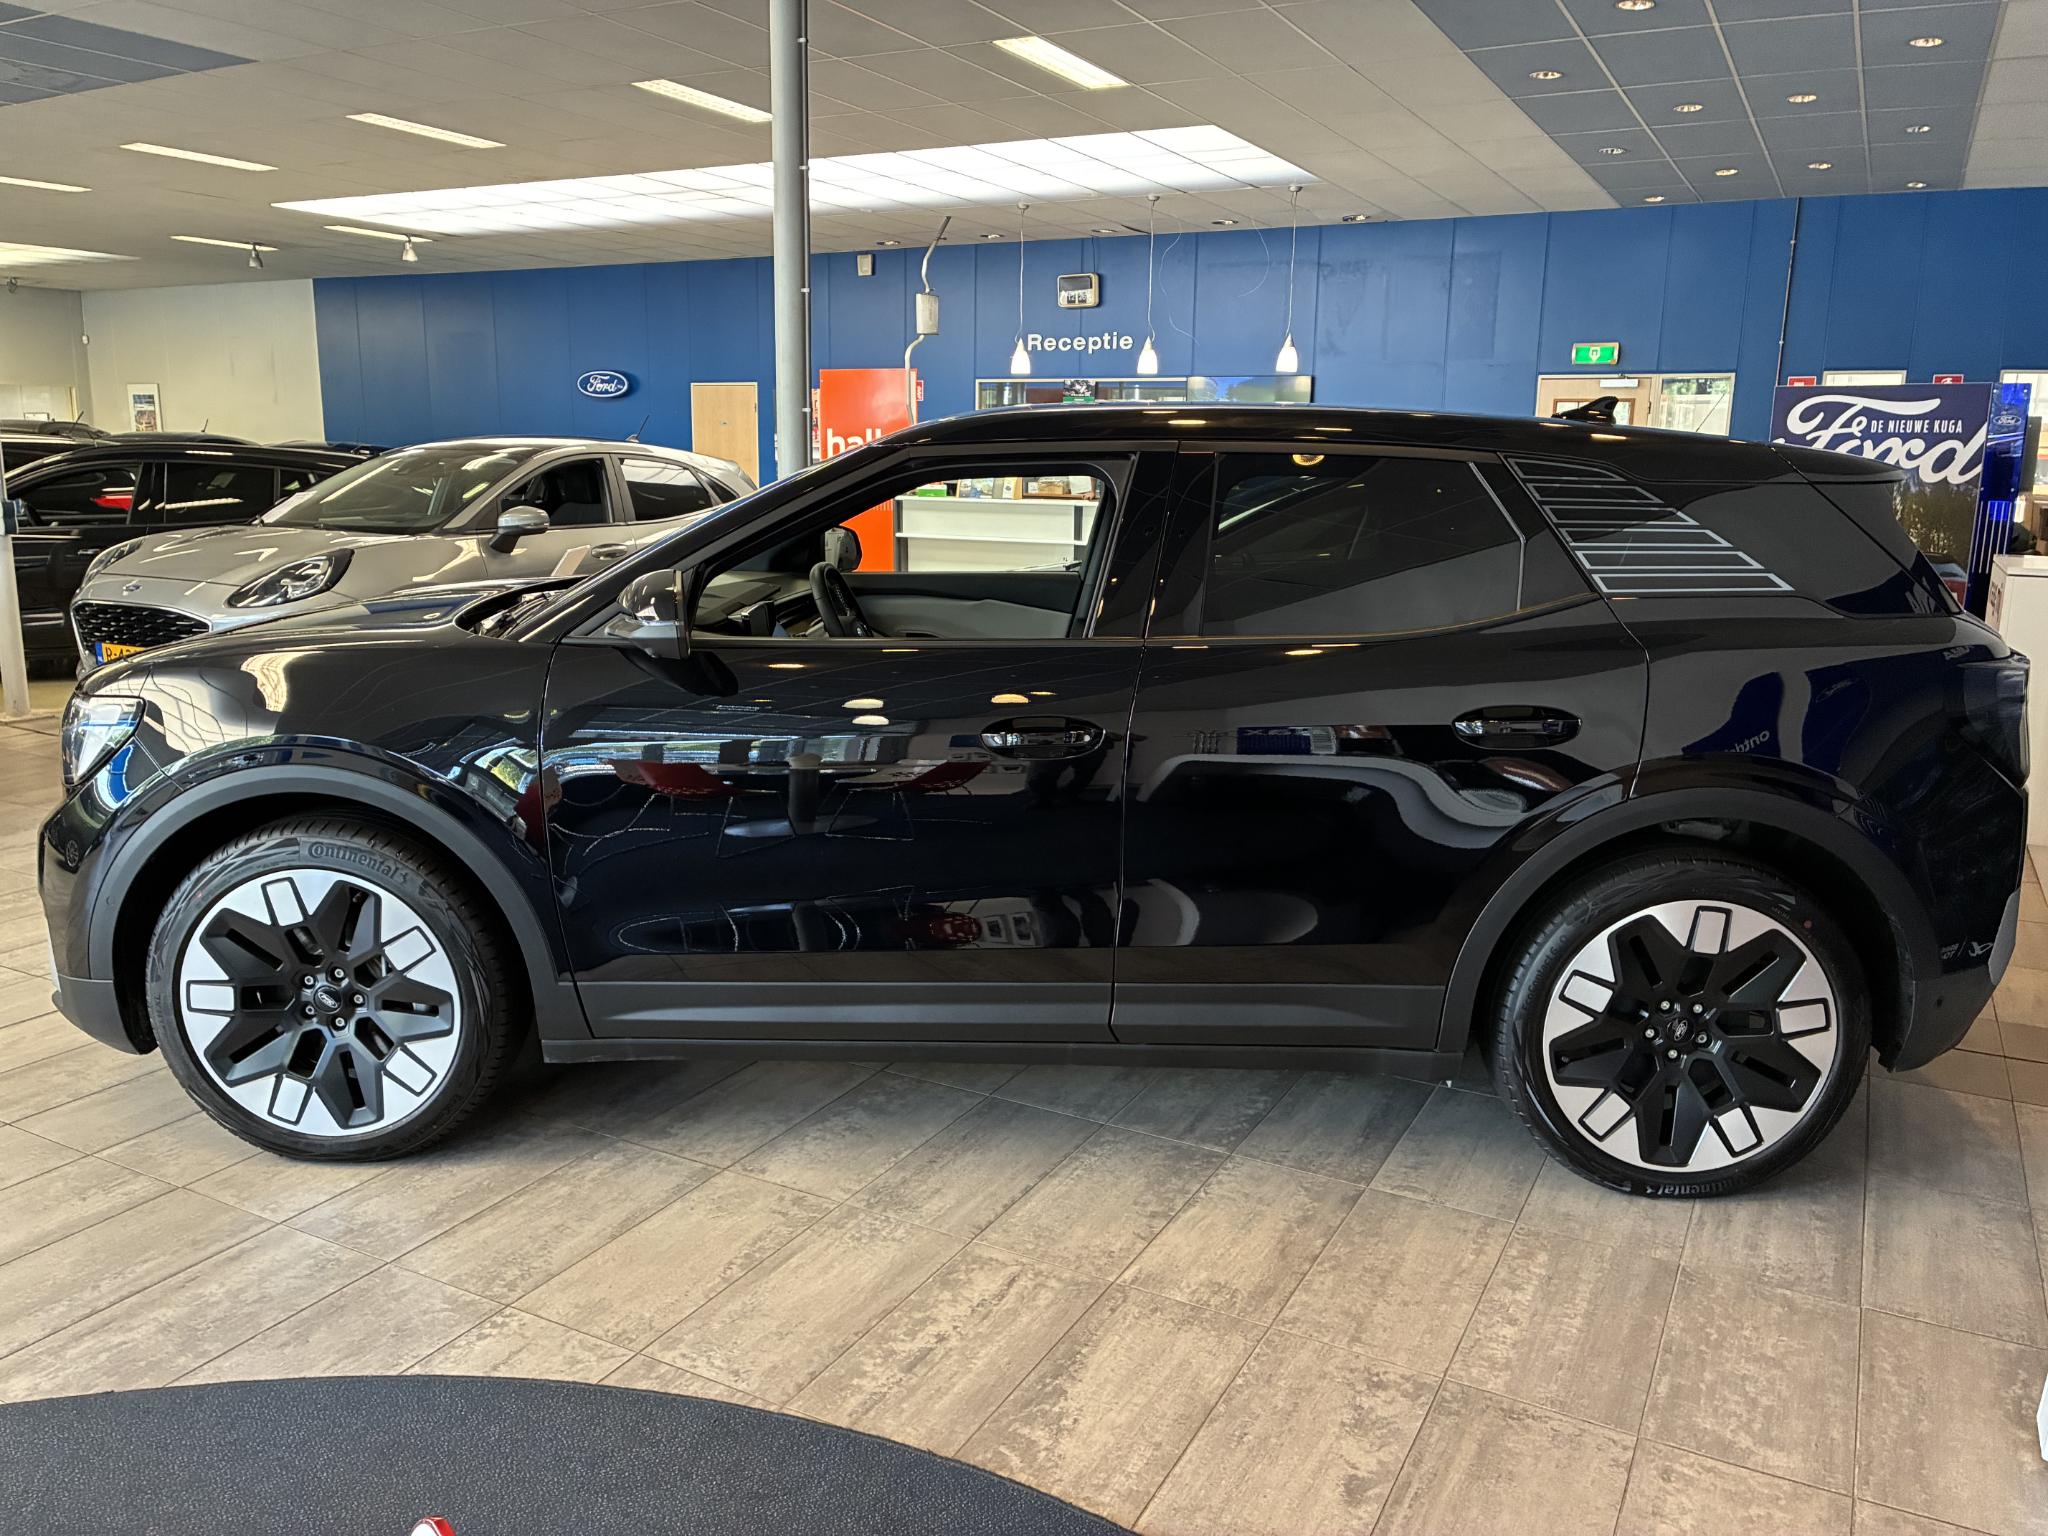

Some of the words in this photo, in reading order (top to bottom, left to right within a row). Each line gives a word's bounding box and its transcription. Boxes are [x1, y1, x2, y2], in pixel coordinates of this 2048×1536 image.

[1027, 332, 1133, 354] Receptie
[587, 374, 618, 392] Ford
[1871, 419, 1884, 433] DE
[1887, 419, 1930, 433] NIEUWE
[1933, 419, 1963, 433] KUGA
[308, 841, 400, 879] Continental
